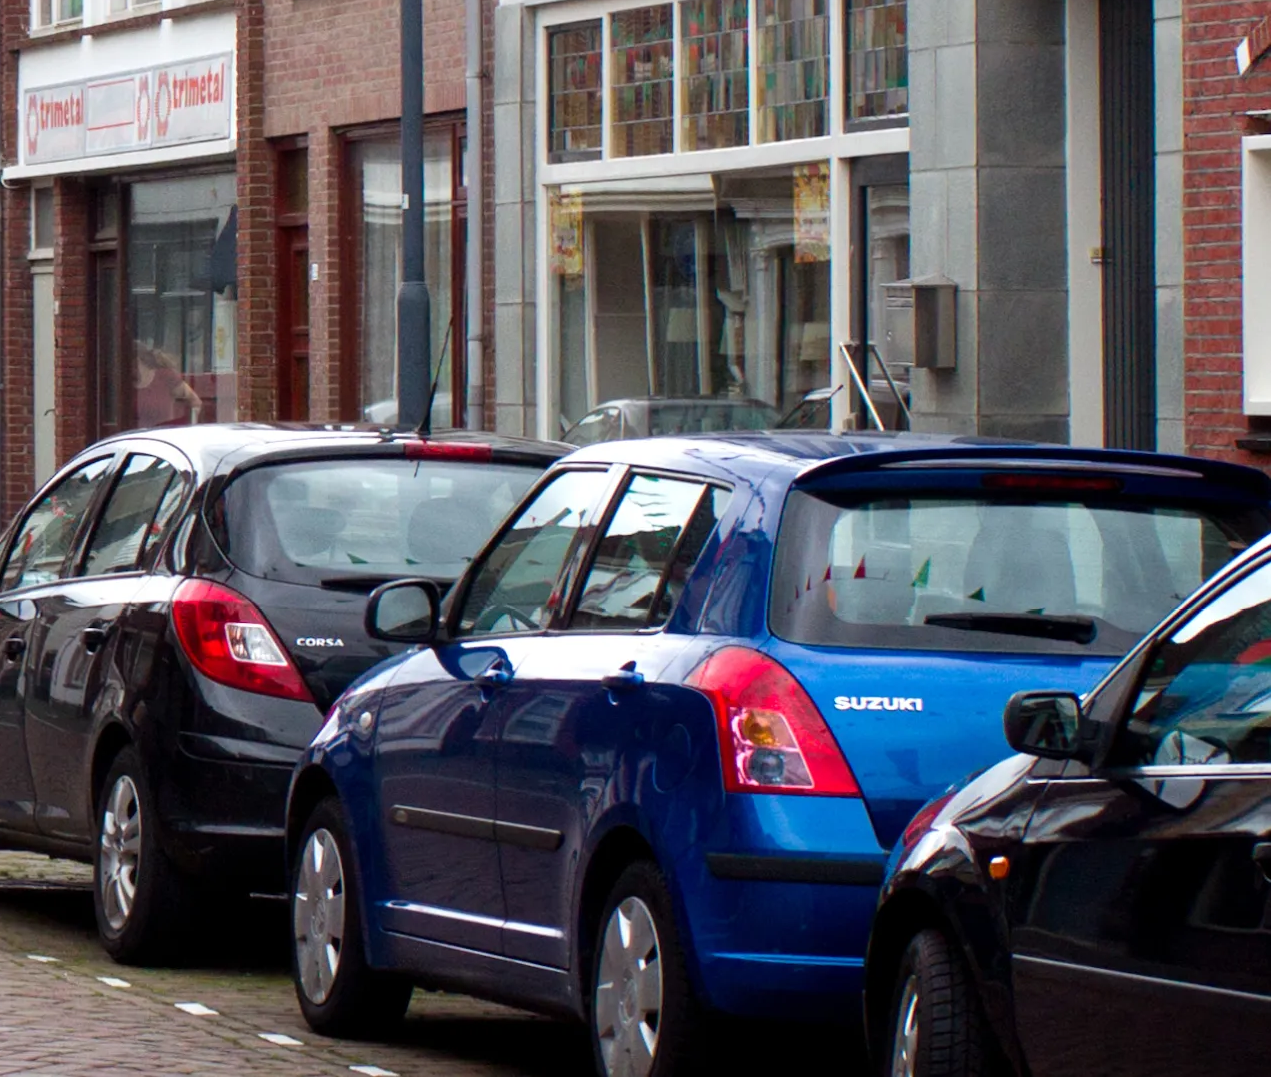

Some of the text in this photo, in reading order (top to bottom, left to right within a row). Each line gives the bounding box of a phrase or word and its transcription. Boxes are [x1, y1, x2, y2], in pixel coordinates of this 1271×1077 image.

[172, 62, 225, 109] trimetal
[39, 89, 84, 131] trimetal
[296, 637, 345, 647] CORSA
[834, 696, 923, 711] SUZUKI
